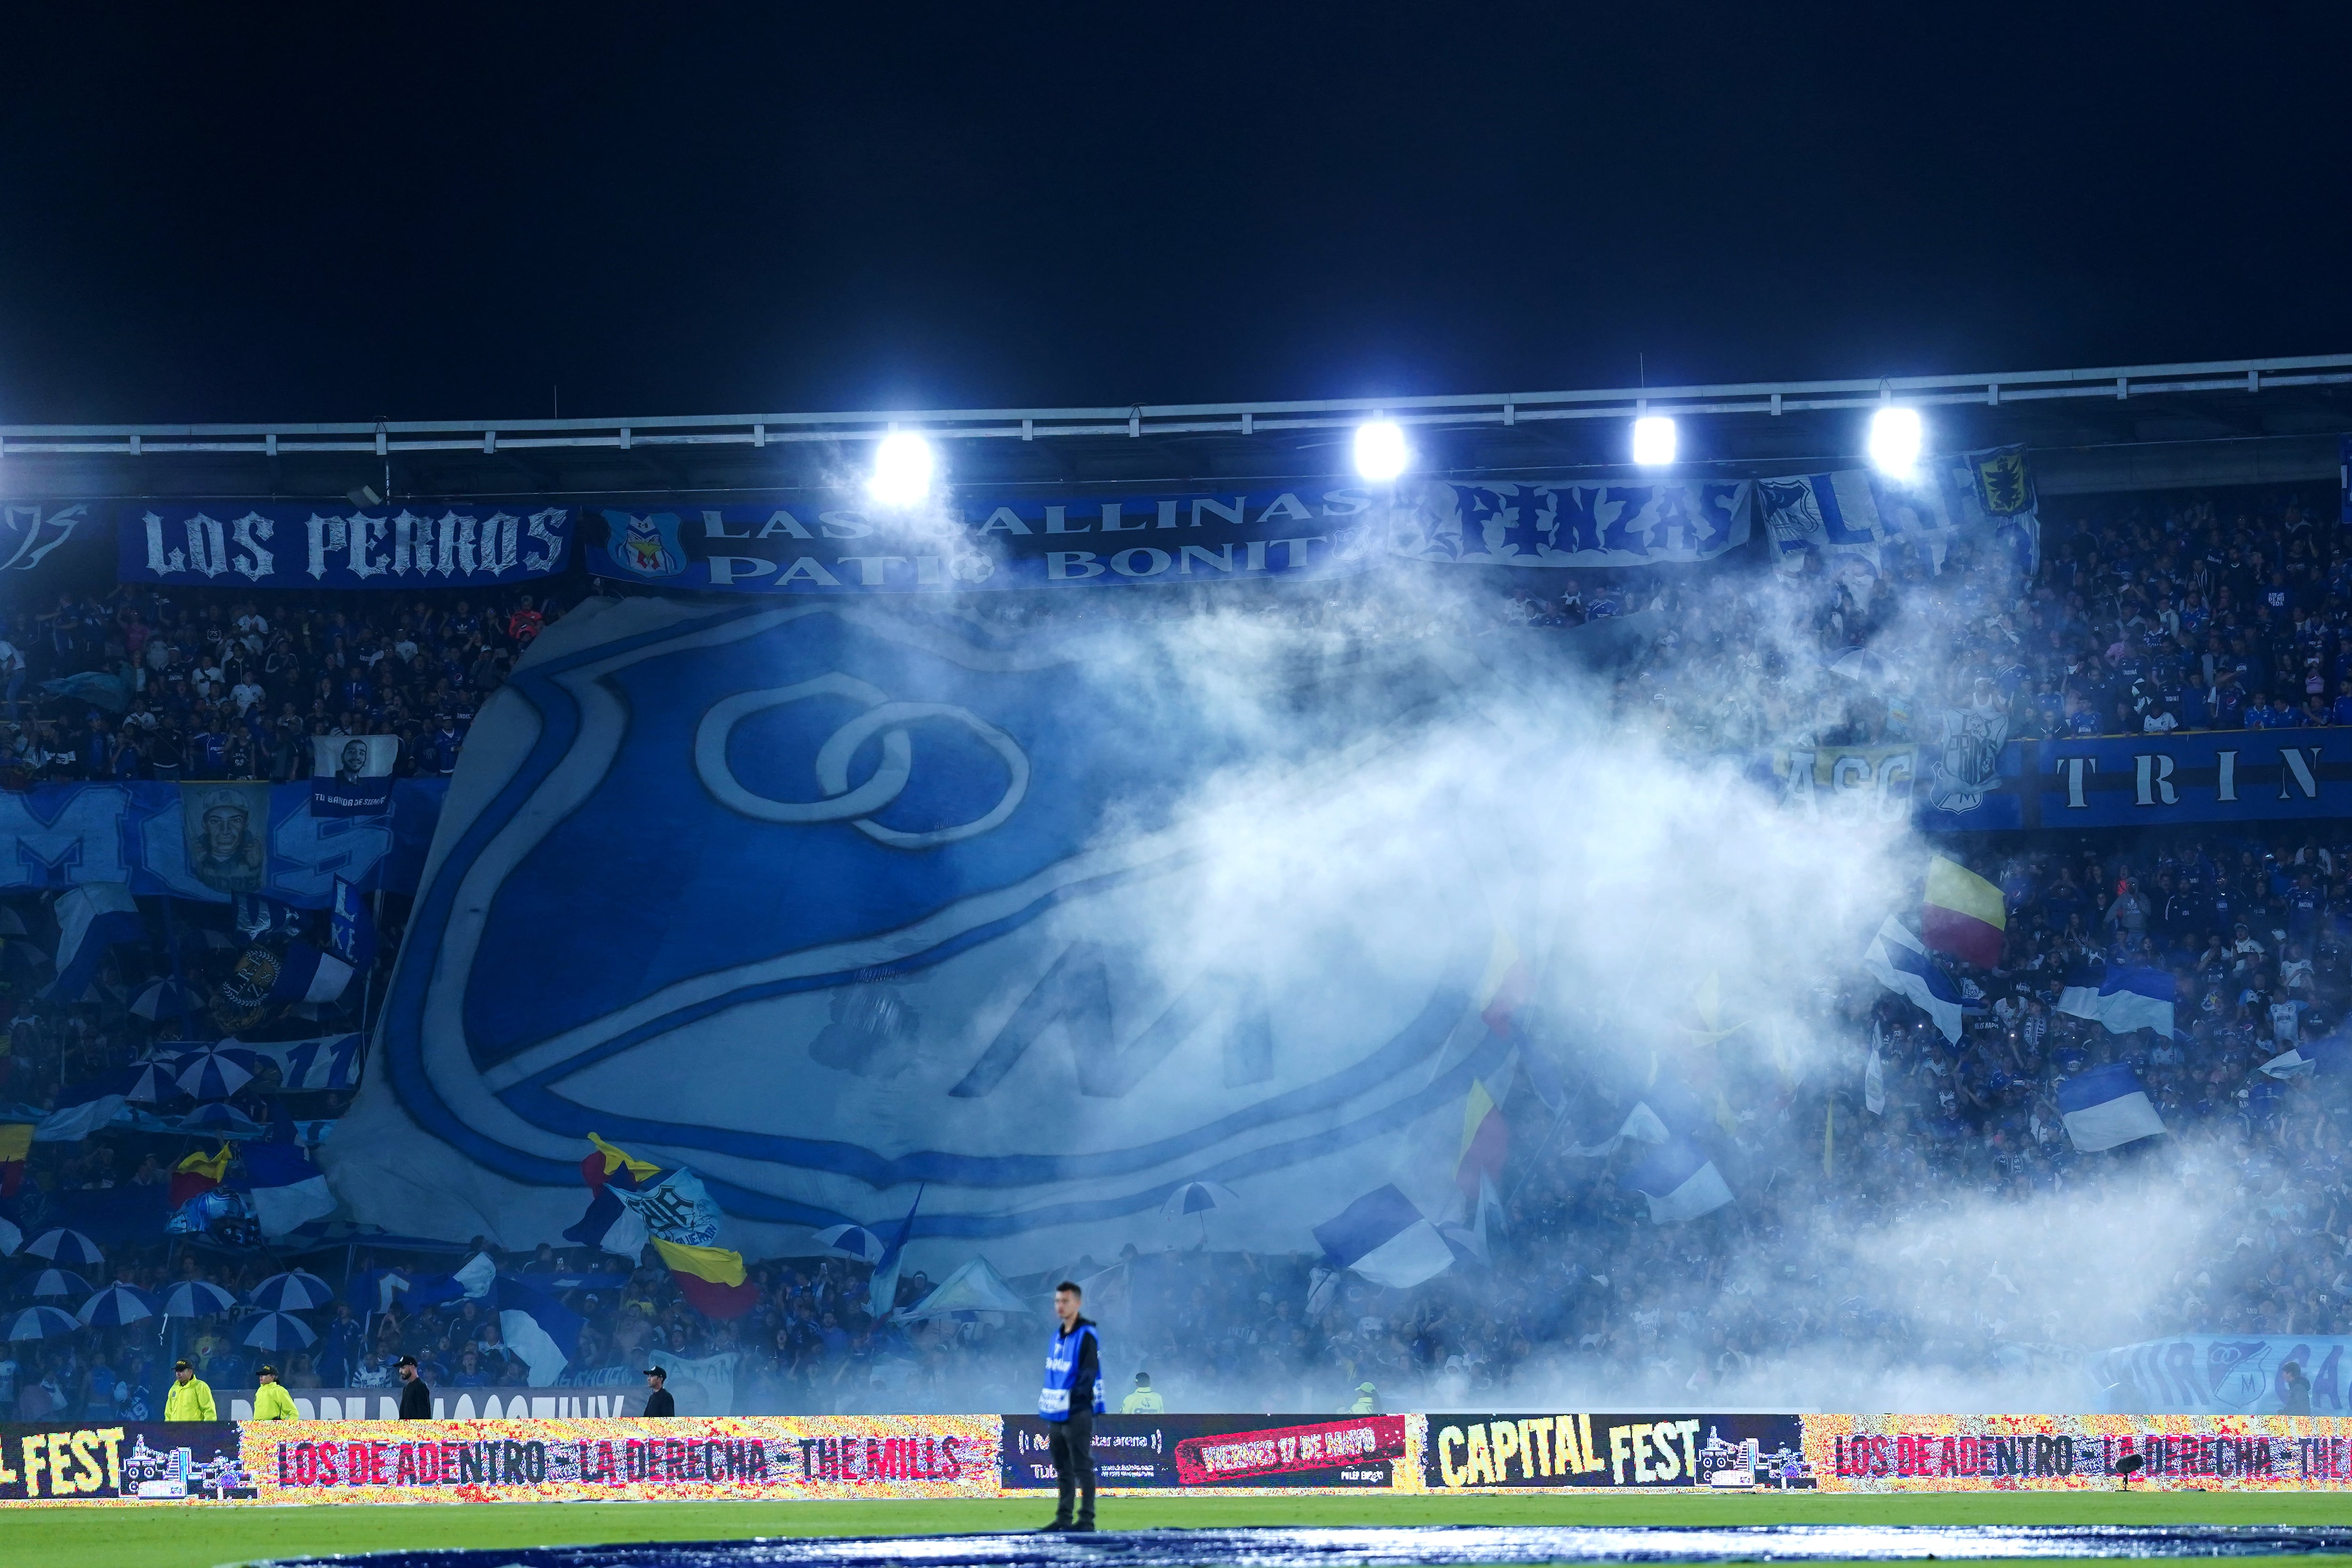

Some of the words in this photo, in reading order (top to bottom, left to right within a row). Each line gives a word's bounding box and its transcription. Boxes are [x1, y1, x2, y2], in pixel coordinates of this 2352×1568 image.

[142, 509, 275, 581] LOS
[304, 506, 569, 581] PERROS
[701, 510, 874, 540] LAS
[315, 793, 325, 801] TU
[327, 795, 353, 807] BANDA
[2056, 747, 2322, 808] TRIN
[22, 1426, 124, 1497] FEST
[278, 1441, 339, 1486] LOS
[349, 1441, 394, 1486] DE
[398, 1439, 546, 1486] ADENTRO
[579, 1439, 619, 1484] LA
[626, 1437, 767, 1484] DERECHA
[798, 1438, 858, 1481] THE
[866, 1436, 961, 1480] MILLS
[1438, 1413, 1605, 1487] CAPITAL
[1609, 1419, 1700, 1485] FEST
[1836, 1435, 1889, 1478] LOS
[1898, 1436, 1939, 1477] DE
[1941, 1436, 2073, 1477] ADENTRO
[2146, 1436, 2272, 1476] DERECHA
